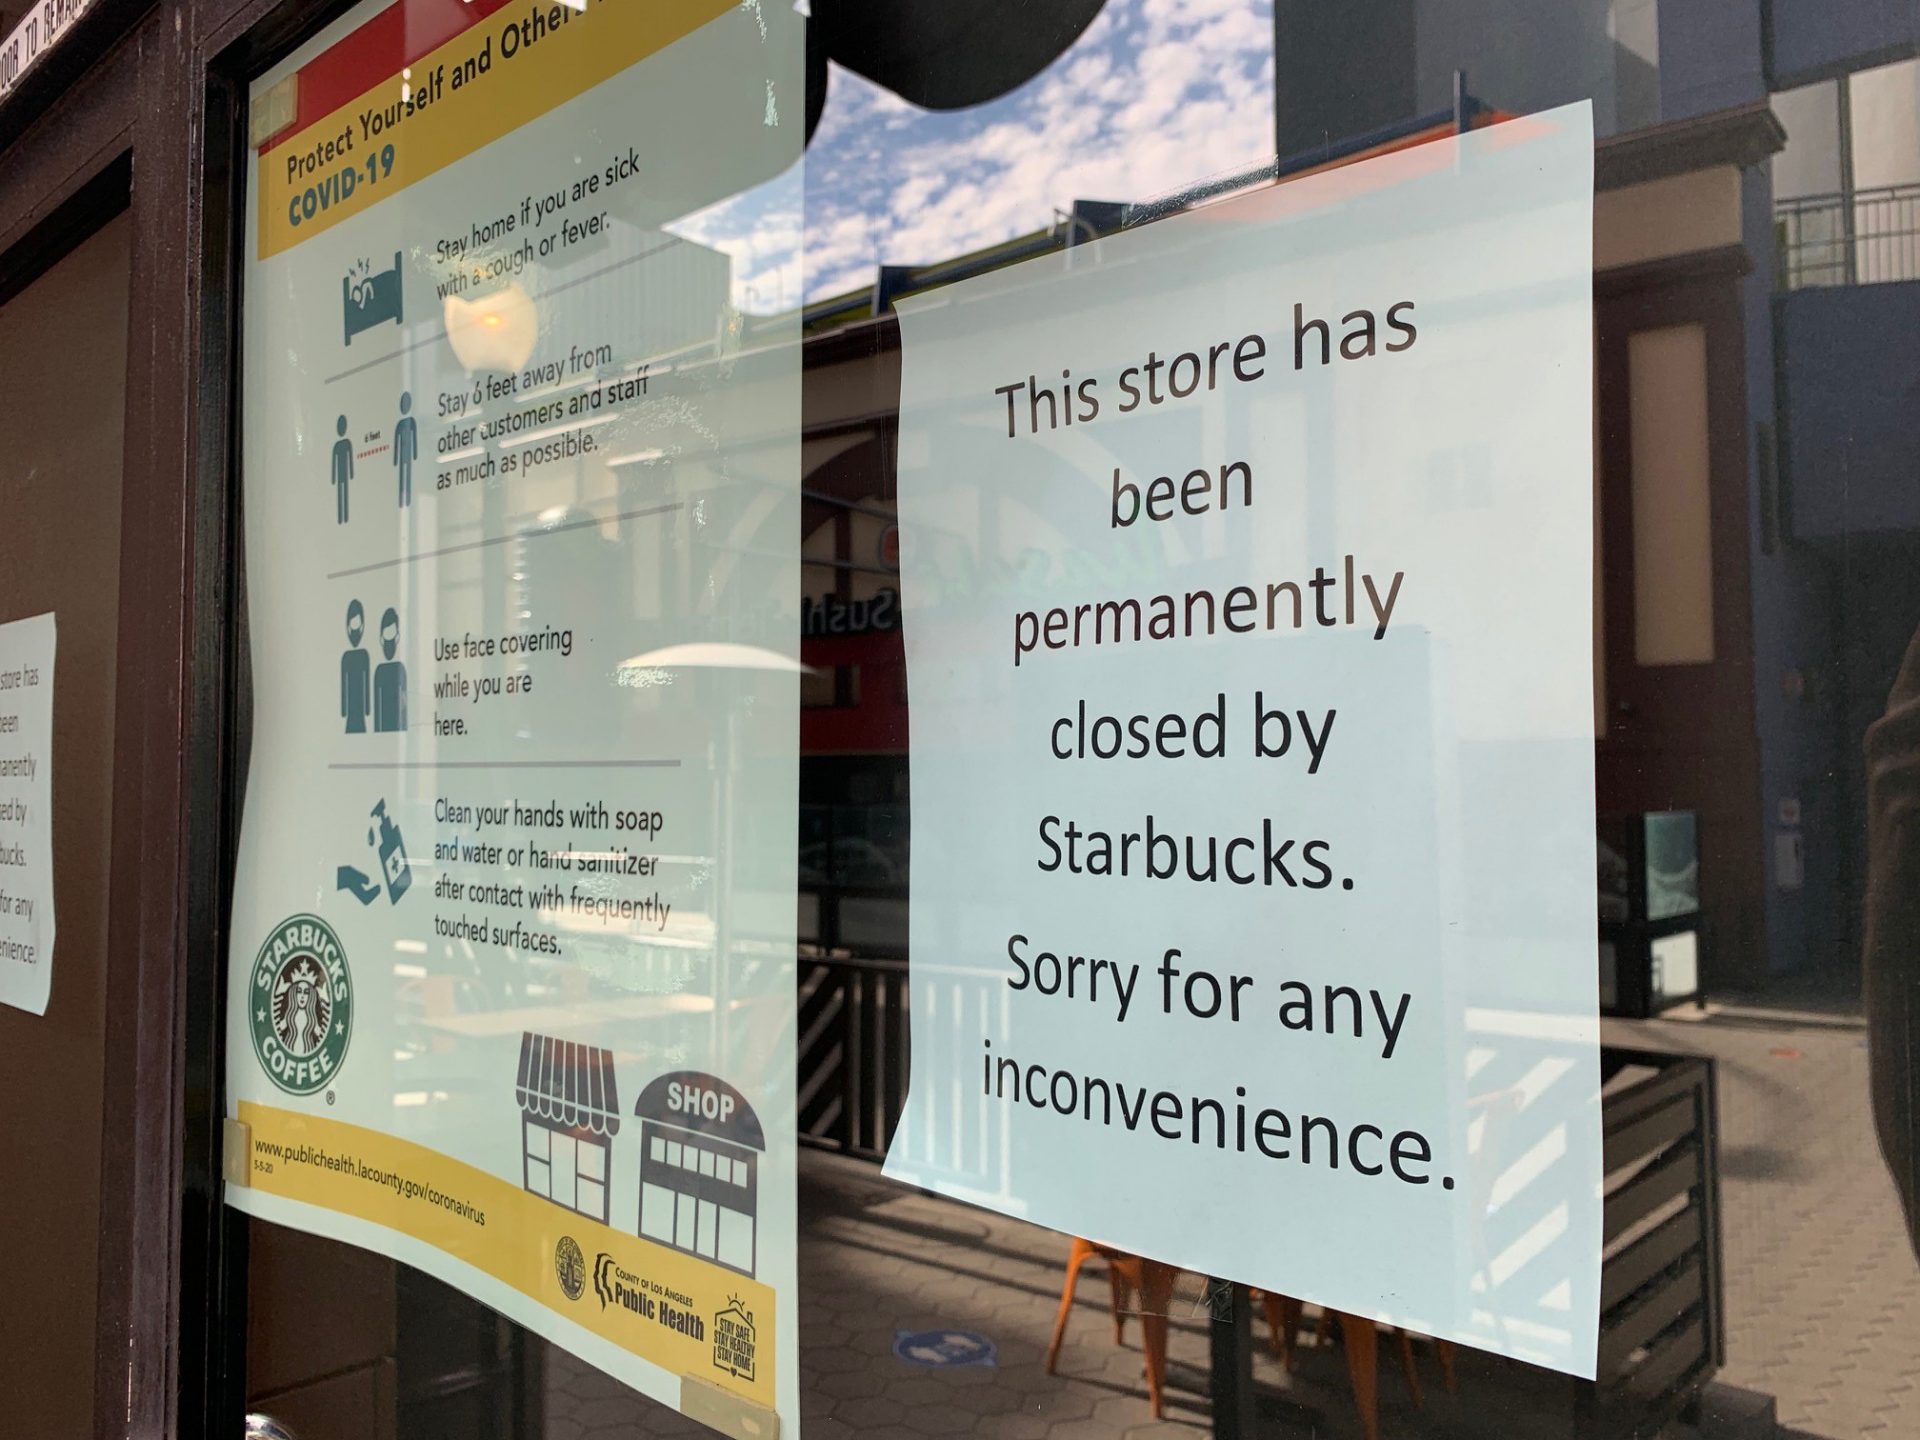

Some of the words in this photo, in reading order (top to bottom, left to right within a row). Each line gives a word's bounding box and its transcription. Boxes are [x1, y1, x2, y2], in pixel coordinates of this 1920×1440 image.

[0, 38, 19, 90] OOR
[25, 17, 38, 62] TO
[287, 125, 353, 184] Protect
[359, 66, 445, 141] Yourself
[451, 37, 492, 90] and
[500, 2, 584, 59] Other
[289, 144, 395, 227] COVID-19
[436, 235, 468, 264] Stay
[472, 214, 516, 249] home
[520, 196, 532, 226] if
[535, 189, 566, 227] you
[572, 174, 600, 202] are
[605, 147, 640, 187] sick
[436, 269, 468, 301] with
[472, 267, 481, 287] a
[485, 238, 534, 280] cough
[539, 234, 557, 256] or
[561, 211, 611, 247] fever.
[438, 391, 469, 418] Stay
[473, 381, 483, 405] 6
[486, 374, 517, 401] feet
[522, 359, 566, 390] away
[570, 344, 612, 375] from
[995, 369, 1099, 438] This
[1118, 334, 1266, 413] store
[1293, 301, 1417, 371] has
[438, 424, 476, 454] other
[479, 404, 563, 441] customers
[569, 380, 601, 415] and
[608, 364, 650, 405] staff
[437, 469, 452, 491] as
[456, 452, 495, 486] much
[500, 454, 517, 474] as
[522, 428, 599, 478] possible.
[1111, 459, 1252, 529] been
[1014, 554, 1405, 667] permanently
[434, 637, 460, 661] Use
[464, 632, 495, 658] face
[500, 624, 573, 657] covering
[24, 664, 39, 687] has
[434, 672, 469, 698] while
[473, 677, 501, 703] you
[506, 674, 532, 693] are
[434, 711, 468, 736] here.
[1051, 692, 1226, 760] closed
[1254, 691, 1337, 774] by
[15, 797, 28, 828] by
[435, 797, 472, 823] Clean
[476, 805, 509, 832] your
[514, 799, 564, 827] hands
[570, 800, 609, 830] with
[615, 810, 664, 842] soap
[435, 836, 458, 862] and
[462, 842, 502, 865] water
[507, 848, 525, 867] or
[530, 840, 571, 871] hand
[577, 846, 659, 877] sanitizer
[1037, 815, 1354, 890] Starbucks.
[15, 898, 34, 923] any
[435, 873, 465, 900] after
[468, 882, 523, 908] contact
[528, 883, 564, 912] with
[570, 885, 671, 932] frequently
[256, 924, 348, 1002] STARBUCKS
[435, 914, 488, 944] touched
[492, 921, 562, 955] surfaces.
[1007, 934, 1139, 1022] Sorry
[1157, 949, 1253, 1022] for
[1279, 980, 1411, 1059] any
[262, 1036, 334, 1085] COFFEE
[667, 1081, 735, 1123] SHOP
[983, 1039, 1455, 1190] inconvenience.
[254, 1159, 274, 1175] 5-5-20
[255, 1138, 486, 1227] www.publichealth.lacounty.gov/coronavirus
[615, 1266, 640, 1286] COUNTY
[650, 1280, 663, 1296] LOS
[664, 1286, 693, 1308] ANGELES
[615, 1281, 655, 1320] Public
[659, 1300, 705, 1342] Health
[714, 1329, 729, 1348] STAY
[729, 1336, 755, 1359] HEALTHY
[717, 1345, 733, 1364] STAY
[733, 1351, 751, 1372] HOME
[719, 1317, 735, 1336] STAY
[735, 1323, 750, 1343] SAFE
